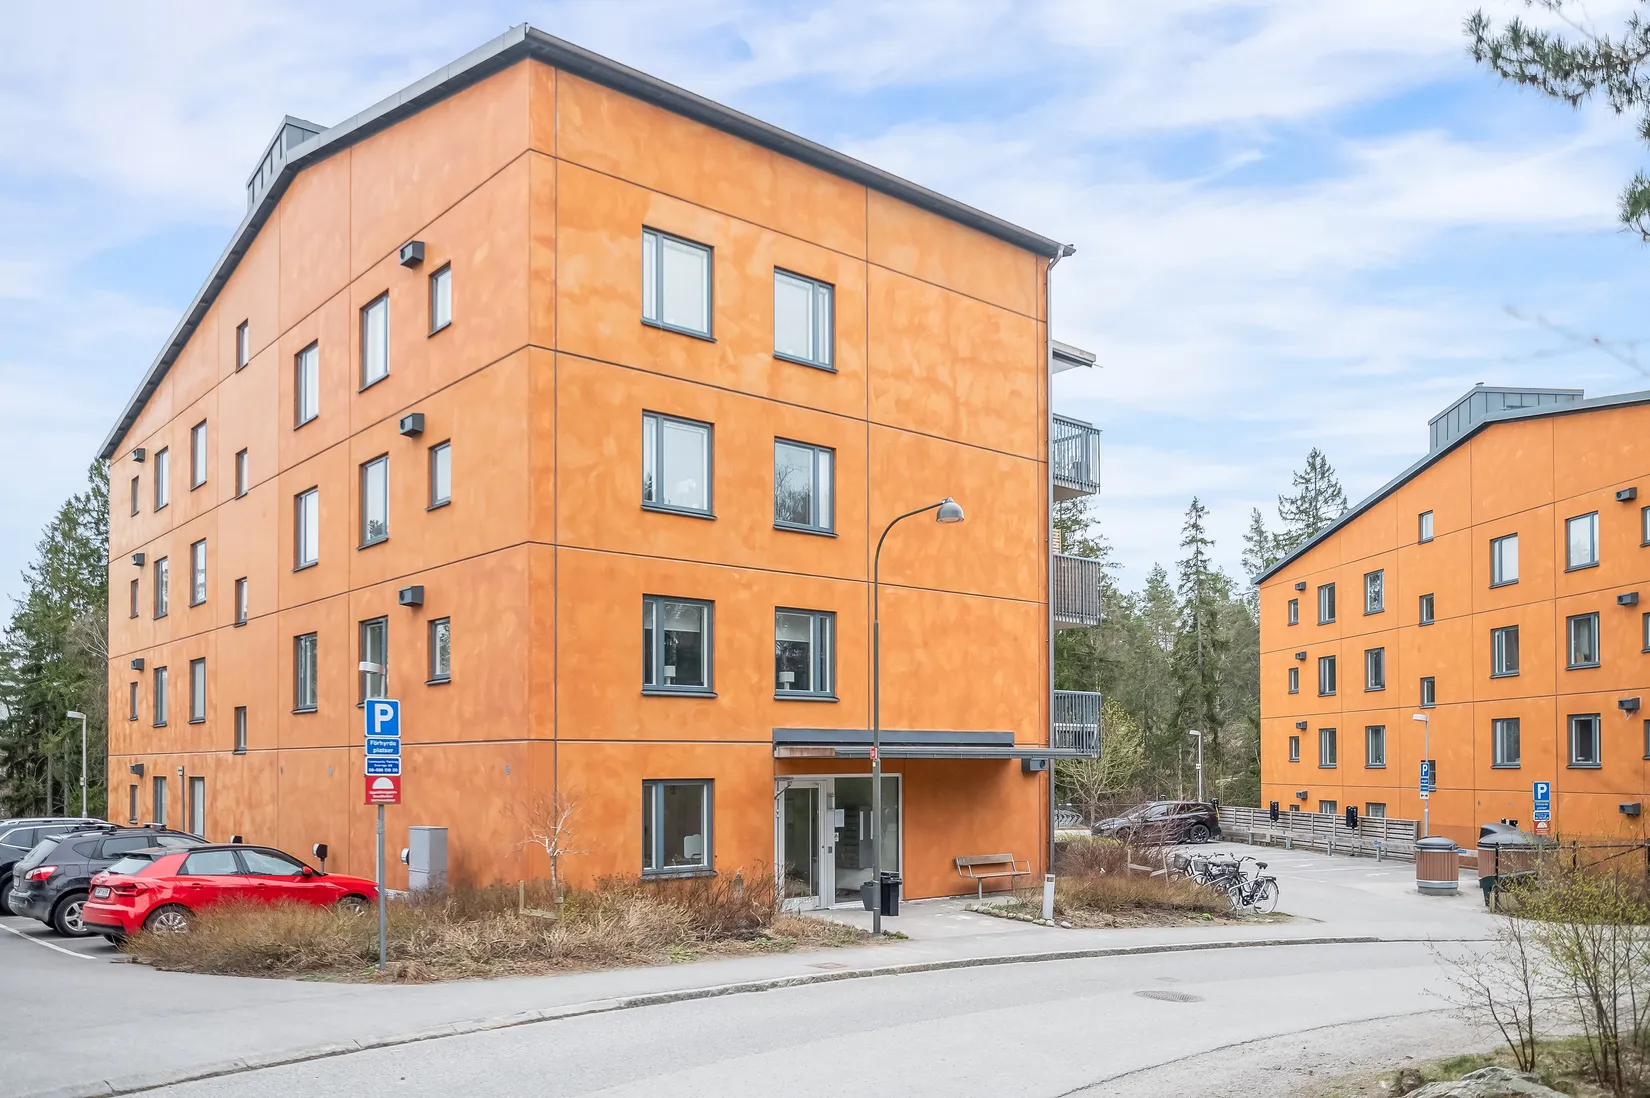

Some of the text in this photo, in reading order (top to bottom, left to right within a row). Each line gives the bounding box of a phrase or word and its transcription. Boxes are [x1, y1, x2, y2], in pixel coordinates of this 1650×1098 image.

[374, 704, 394, 732] P
[1422, 764, 1428, 776] P
[1537, 783, 1548, 799] P
